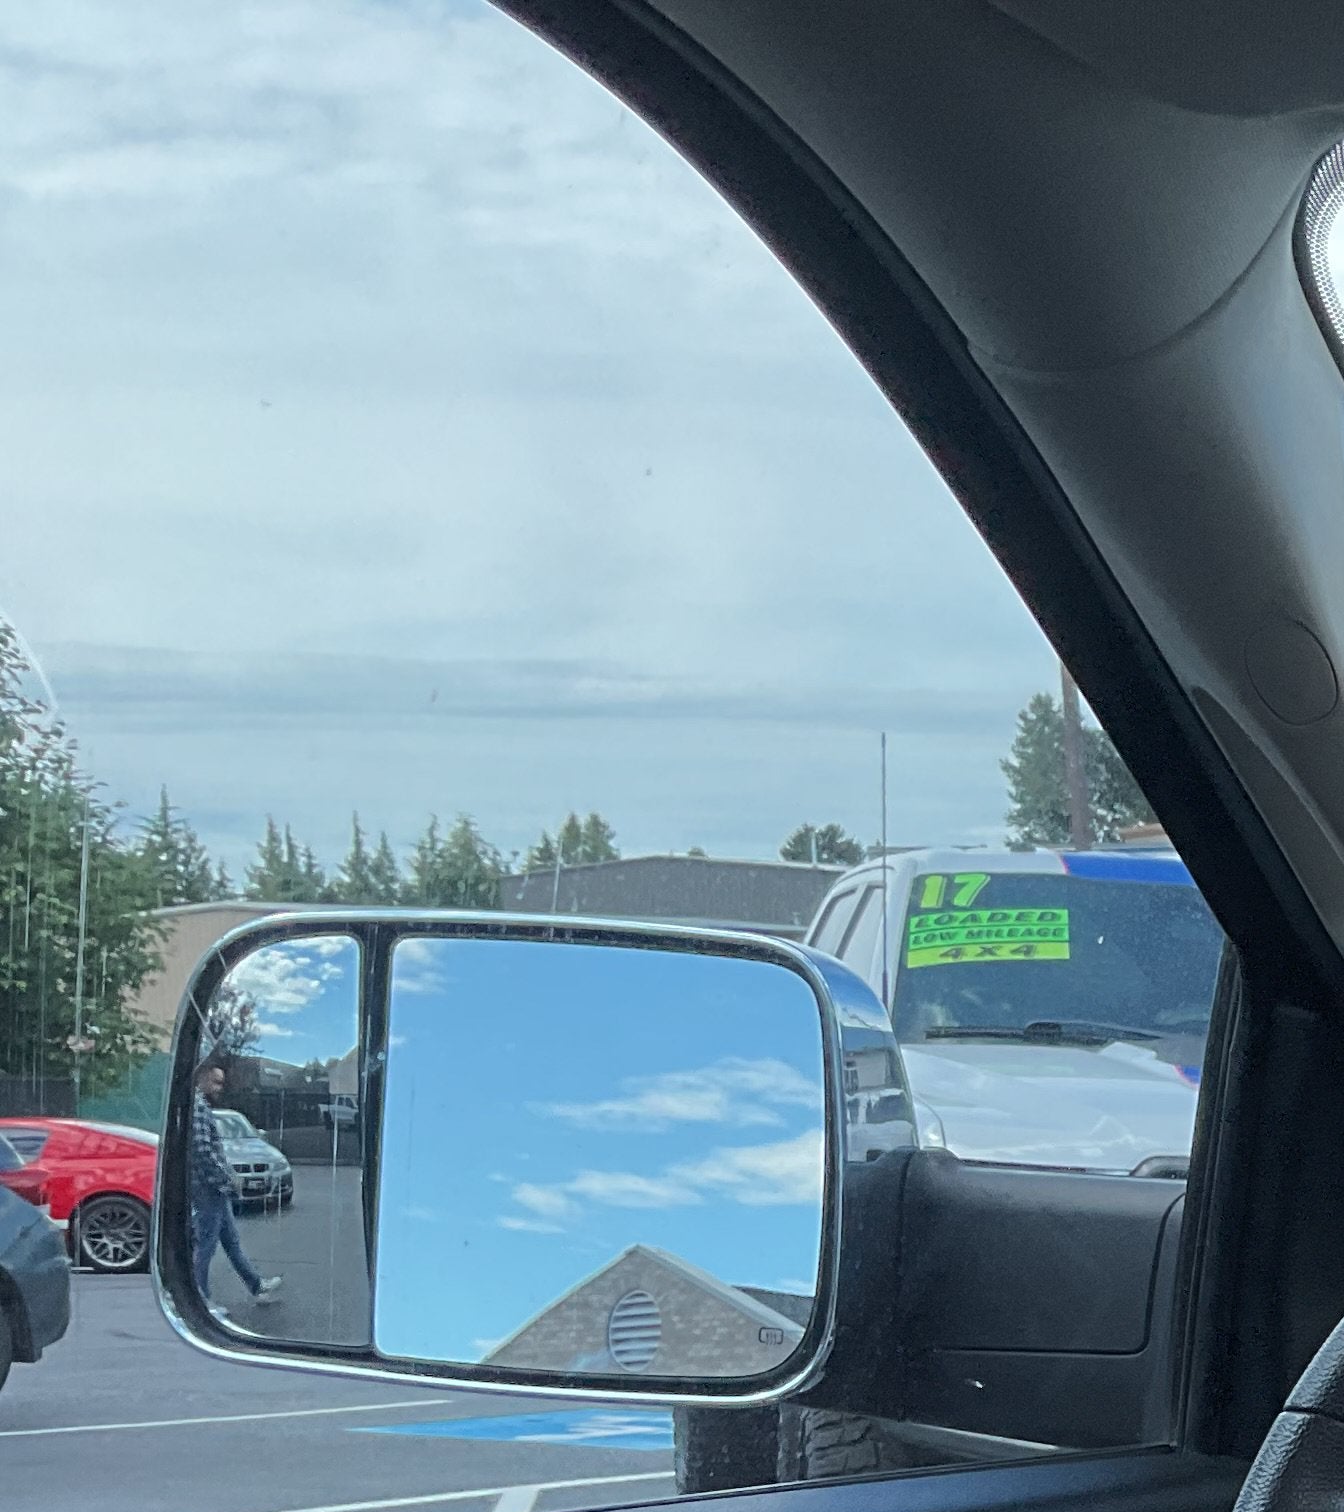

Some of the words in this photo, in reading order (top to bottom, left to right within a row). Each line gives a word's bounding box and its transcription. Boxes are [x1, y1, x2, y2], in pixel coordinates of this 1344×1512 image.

[920, 872, 990, 908] 17
[915, 911, 1062, 928] LOADED
[912, 931, 958, 946] LOW
[965, 927, 1065, 940] MILEAGE
